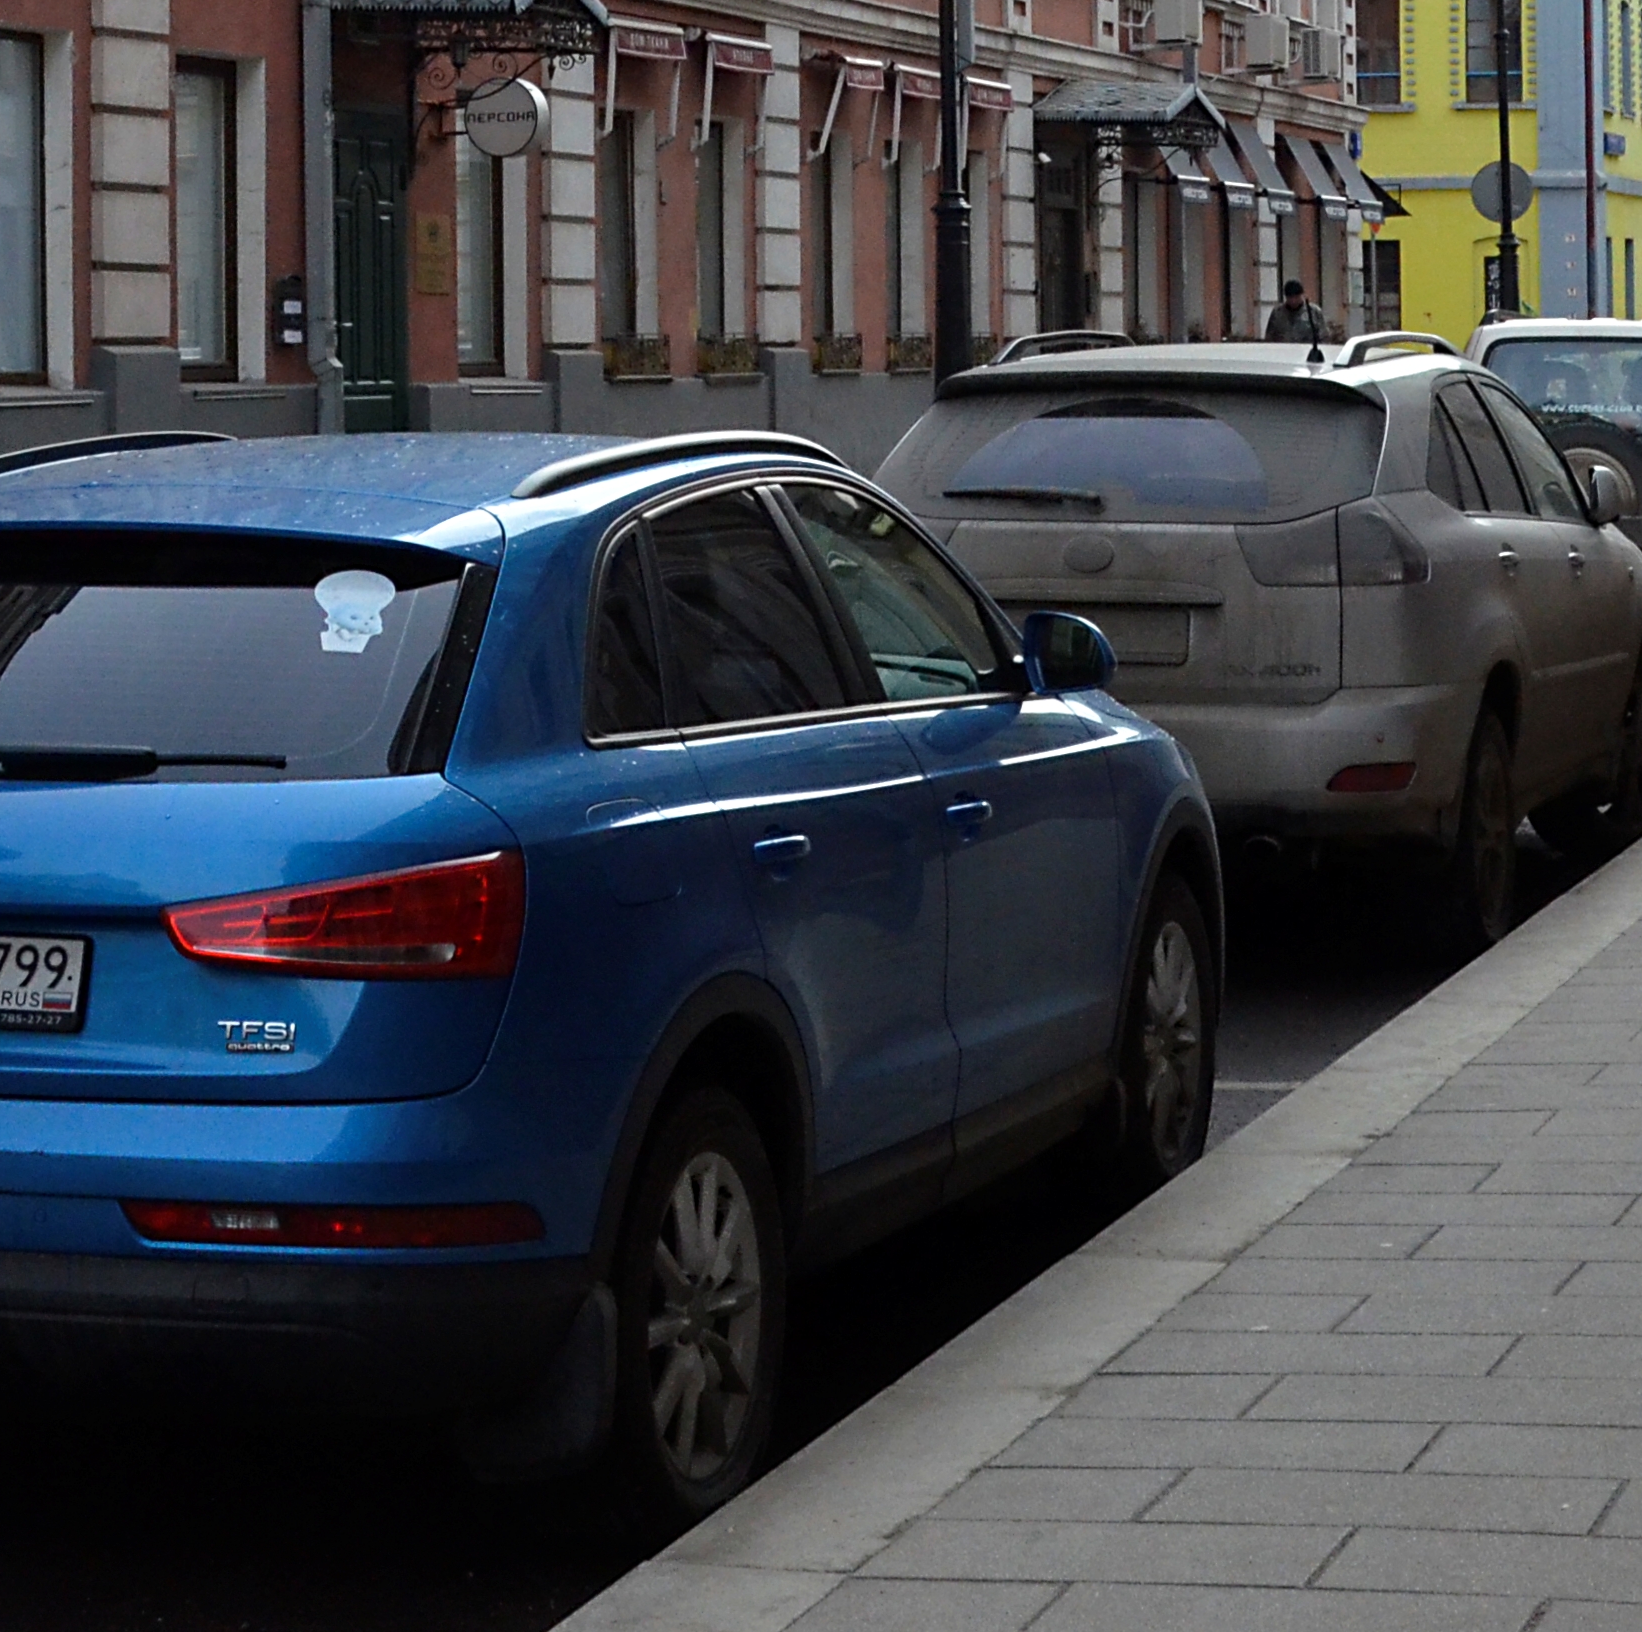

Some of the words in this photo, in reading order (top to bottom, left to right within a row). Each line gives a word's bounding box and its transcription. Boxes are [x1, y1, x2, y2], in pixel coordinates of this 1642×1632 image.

[466, 111, 536, 123] ПЕРСОНА
[0, 990, 41, 1008] RUS
[217, 1020, 296, 1040] TFSI
[227, 1042, 291, 1051] quattro
